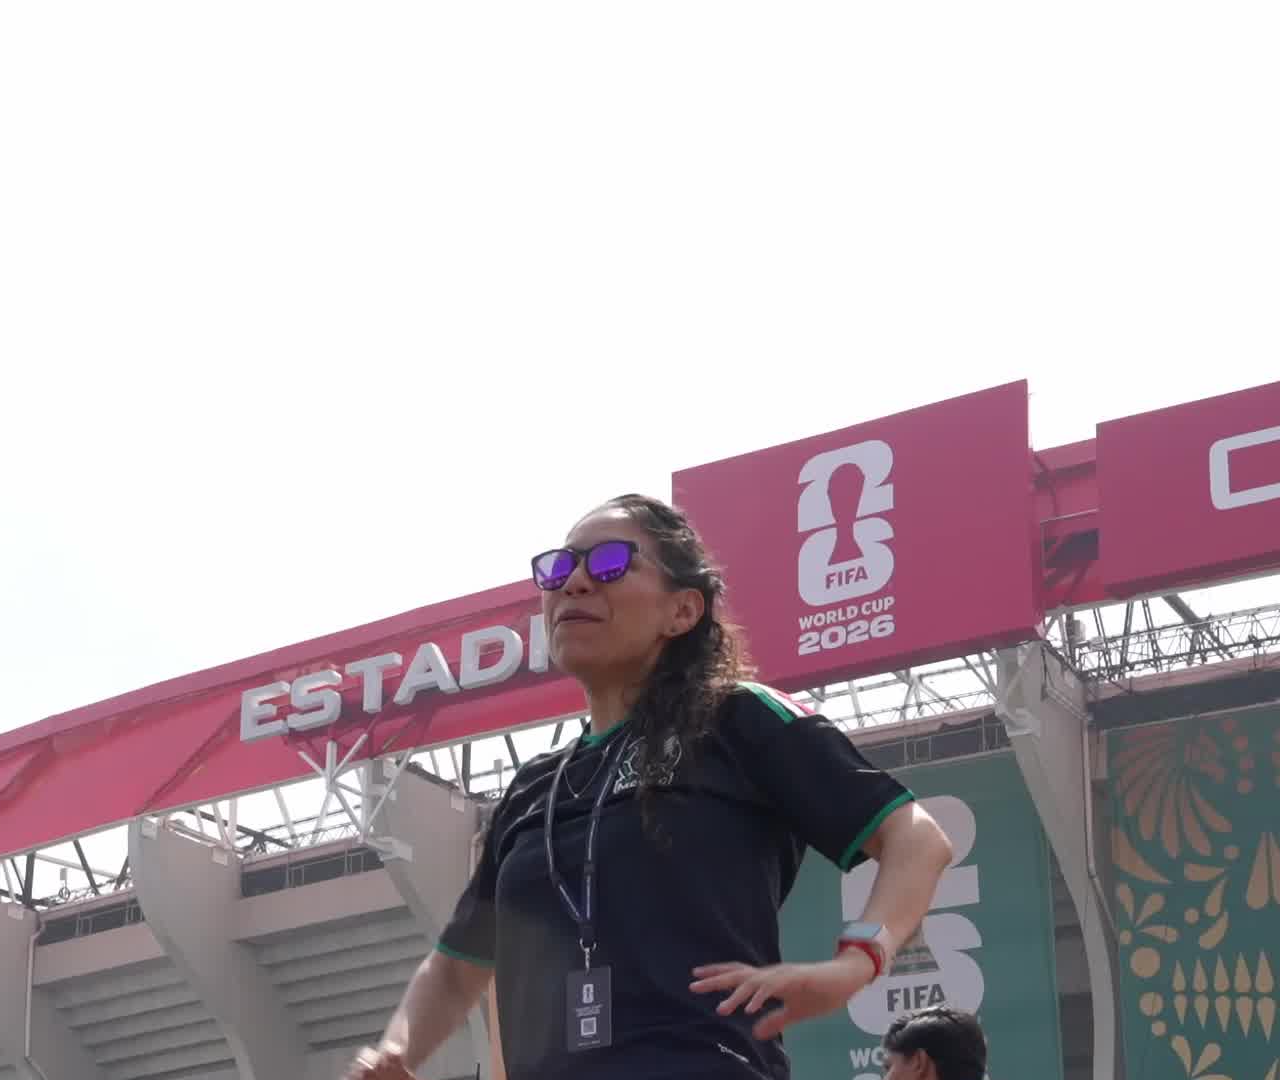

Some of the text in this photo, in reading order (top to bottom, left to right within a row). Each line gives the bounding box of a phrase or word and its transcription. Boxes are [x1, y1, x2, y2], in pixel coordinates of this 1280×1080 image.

[825, 565, 868, 590] FIFA
[798, 596, 895, 631] WORLD CUP
[798, 614, 895, 656] 2026
[239, 614, 549, 742] ESTADI
[886, 983, 946, 1012] FIFA
